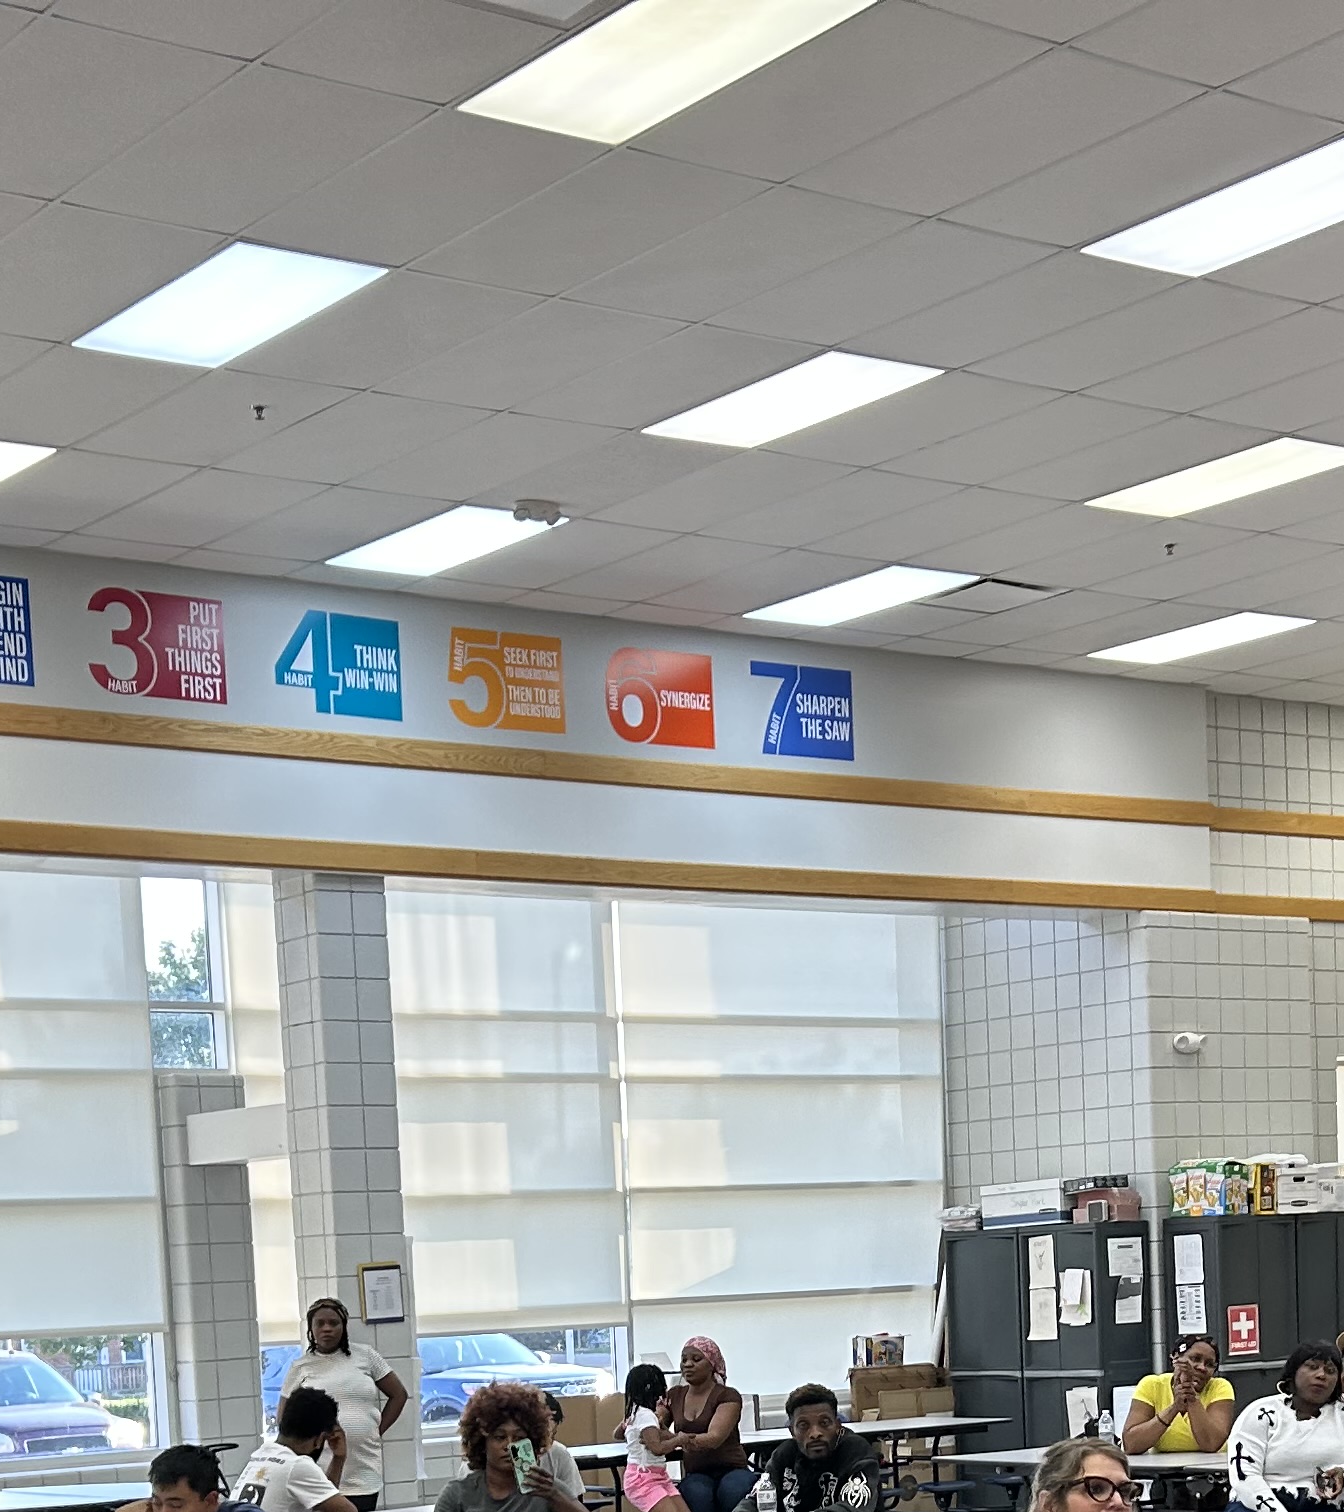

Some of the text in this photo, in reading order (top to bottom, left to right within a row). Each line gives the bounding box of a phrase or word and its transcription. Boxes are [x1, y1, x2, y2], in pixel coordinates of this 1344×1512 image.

[189, 601, 218, 626] PUT
[87, 587, 157, 695] 3
[177, 624, 220, 651] FIRST
[165, 647, 221, 676] THINGS
[275, 609, 341, 714] 4
[354, 644, 397, 671] THINK
[453, 636, 465, 671] HABIT
[503, 647, 558, 668] SEEK FIRST
[107, 678, 138, 693] HABIT
[180, 674, 222, 701] FIRST
[284, 671, 313, 687] HABIT
[344, 667, 397, 693] WIN-WIN
[448, 626, 504, 729] 5
[507, 685, 533, 703] THEN
[534, 687, 546, 704] TO
[660, 689, 711, 711] SYNERGIZE
[750, 660, 800, 755] 7
[796, 692, 850, 718] SHARPEN
[767, 712, 782, 745] HABIT
[800, 717, 851, 742] THE SAW
